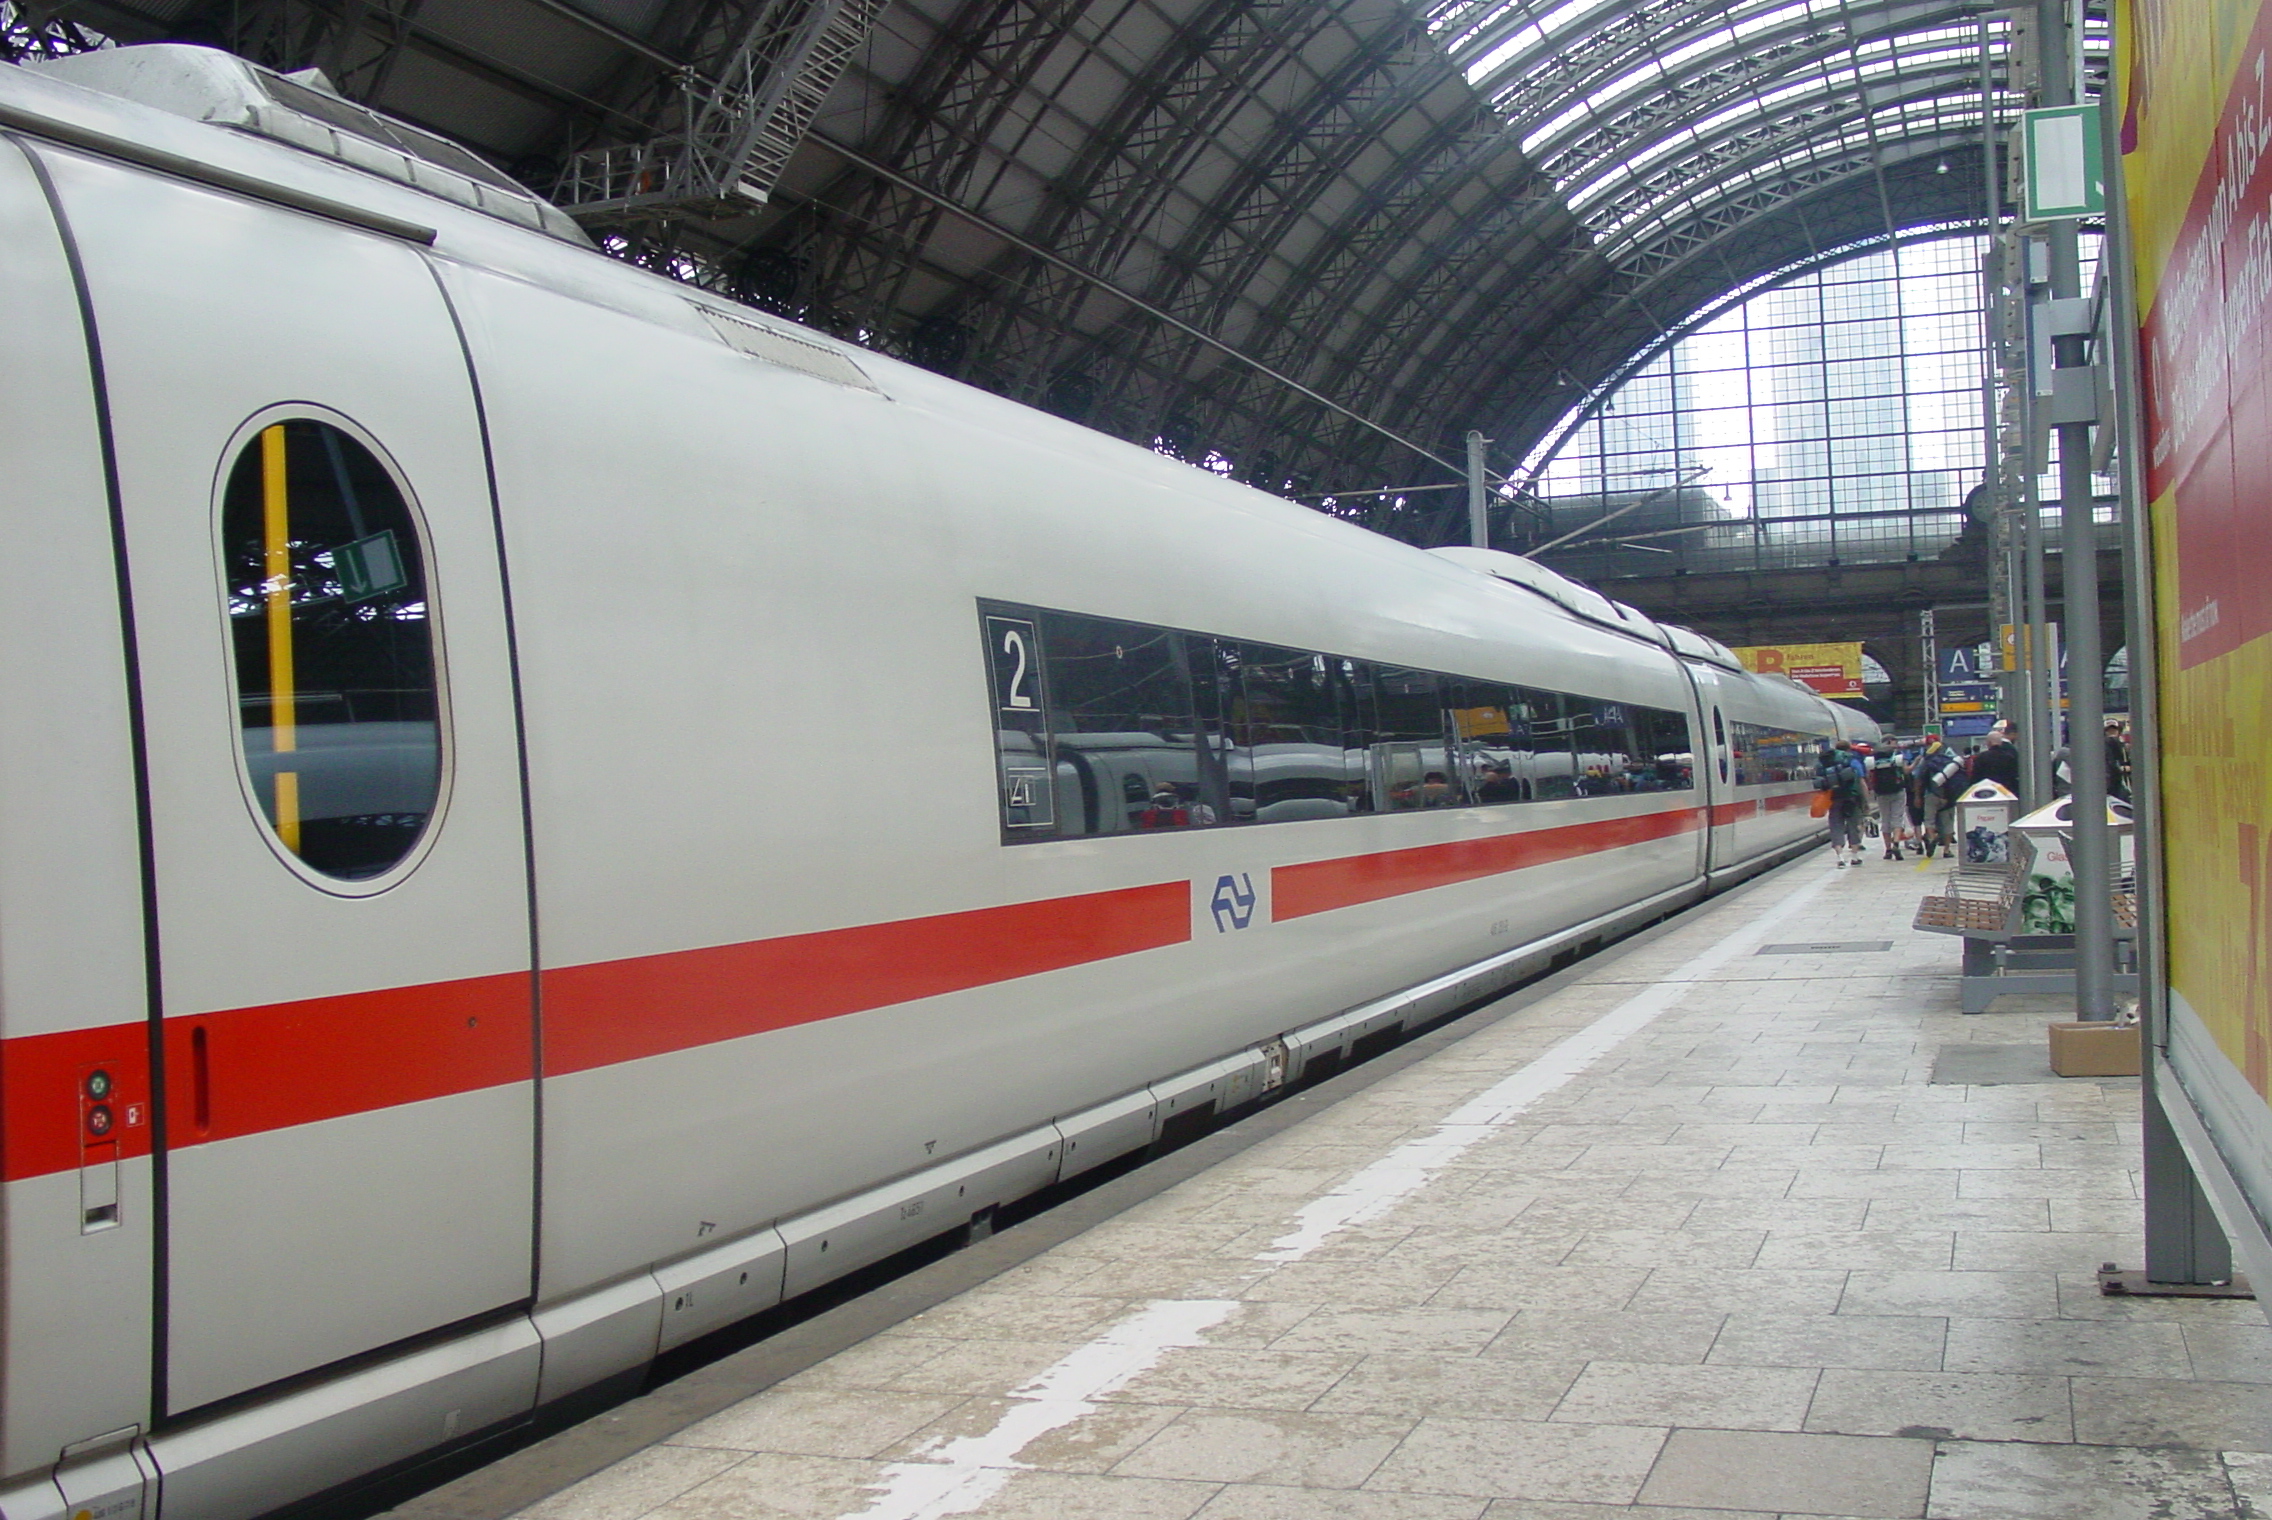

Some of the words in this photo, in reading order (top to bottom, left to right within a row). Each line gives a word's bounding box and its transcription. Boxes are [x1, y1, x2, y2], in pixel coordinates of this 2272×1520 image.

[2228, 134, 2238, 224] A
[2236, 96, 2256, 200] bis
[1003, 630, 1031, 707] 2
[1949, 650, 1969, 673] A
